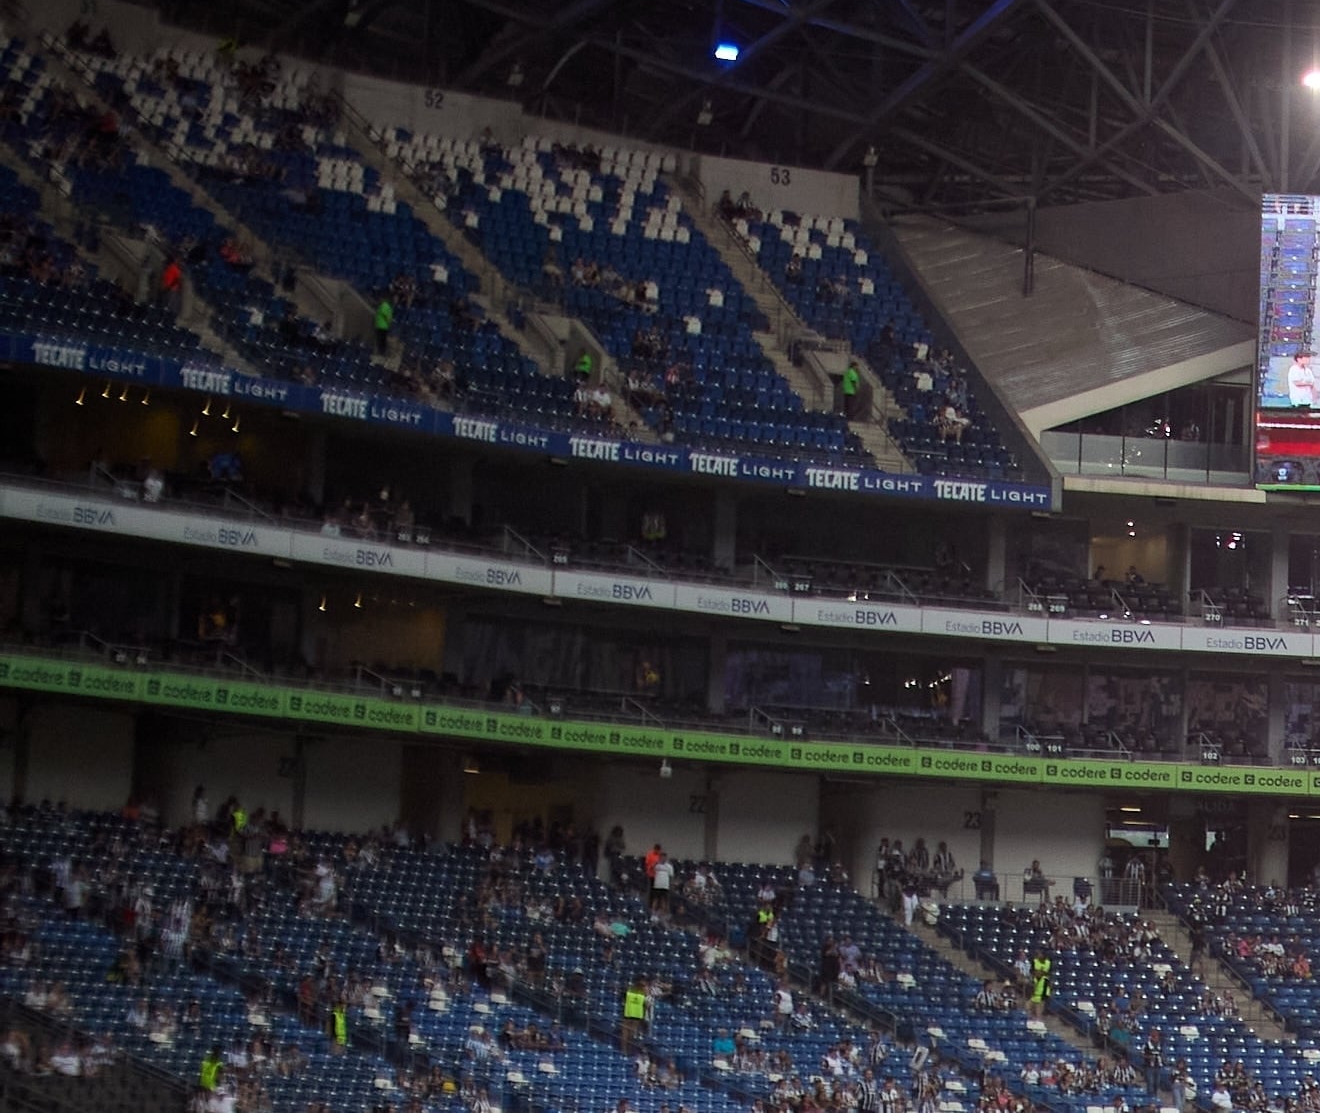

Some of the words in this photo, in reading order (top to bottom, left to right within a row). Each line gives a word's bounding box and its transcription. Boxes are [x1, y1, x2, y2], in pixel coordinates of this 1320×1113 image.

[425, 91, 444, 109] 52
[770, 167, 791, 186] 53
[34, 342, 85, 370] TECATE
[90, 359, 146, 376] LIGHT
[180, 367, 230, 394] TECATE
[234, 382, 287, 400] LIGHT
[322, 393, 368, 419] TECATE
[371, 406, 423, 424] LIGHT
[453, 416, 498, 443] TECATE
[501, 430, 549, 449] LIGHT
[570, 437, 620, 461] TECATE
[623, 448, 679, 465] LIGHT
[689, 453, 738, 477] TECATE
[742, 464, 796, 481] LIGHT
[806, 467, 860, 490] TECATE
[864, 479, 922, 493] LIGHT
[934, 480, 986, 501] TECATE
[990, 490, 1048, 505] LIGHT
[486, 568, 522, 586] BBVA
[612, 583, 653, 600] BBVA
[731, 597, 771, 615] BBVA
[855, 611, 898, 626] BBVA
[945, 620, 981, 634] Estadio
[982, 622, 1024, 636] BBVA
[1072, 629, 1110, 643] Estadio
[1111, 630, 1155, 644] BBVA
[1205, 636, 1243, 650] Estadio
[1244, 637, 1287, 651] BBVA
[994, 763, 1038, 776] codere
[1061, 766, 1106, 779] codere
[1125, 770, 1170, 781] codere
[1196, 773, 1240, 785] codere
[1257, 775, 1302, 789] codere
